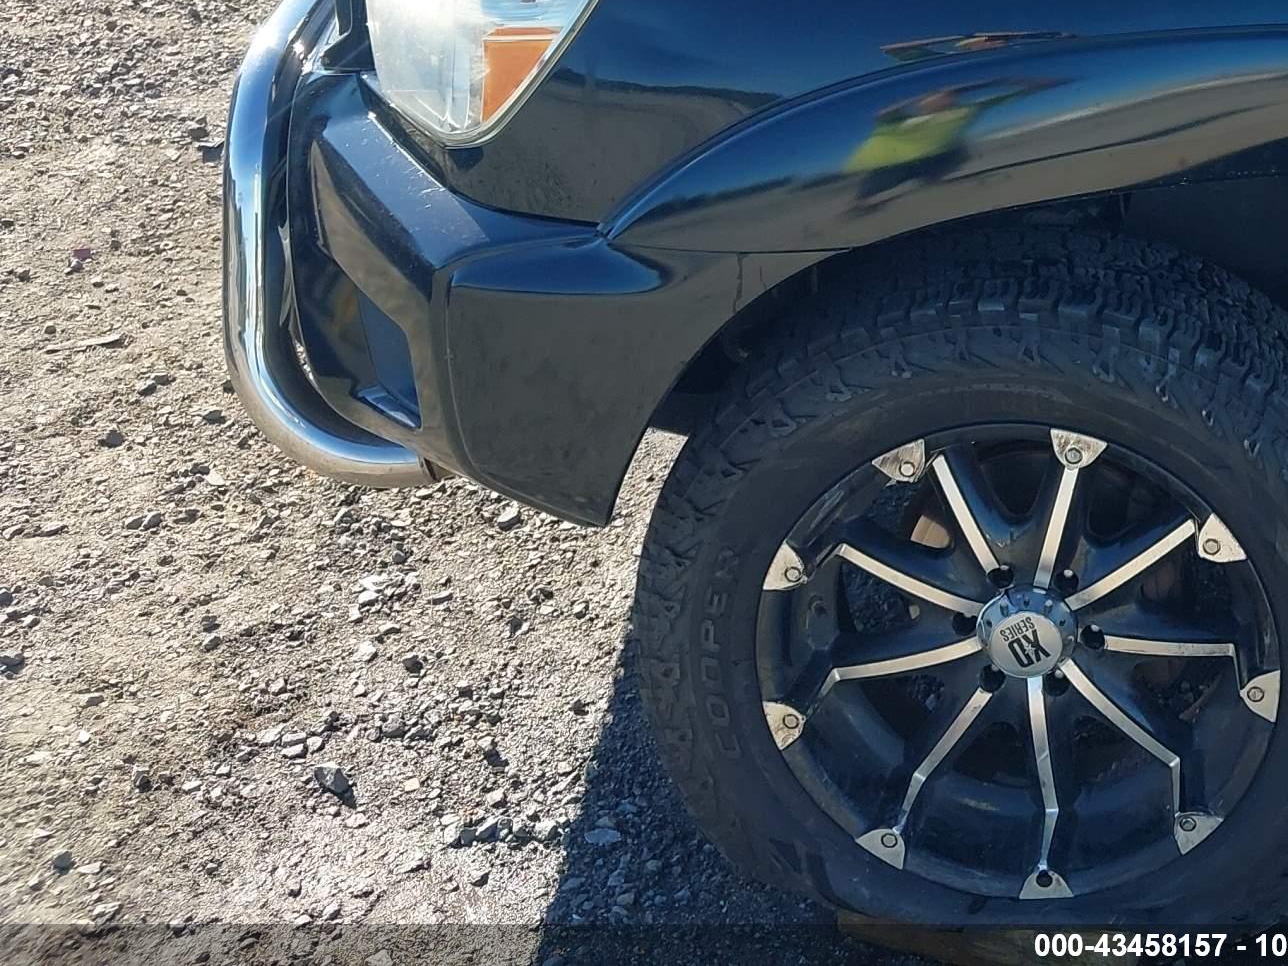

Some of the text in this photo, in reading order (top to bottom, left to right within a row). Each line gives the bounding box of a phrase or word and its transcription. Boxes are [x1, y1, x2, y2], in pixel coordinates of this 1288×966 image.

[1000, 616, 1036, 642] SERIES
[1008, 629, 1052, 668] XD
[701, 546, 742, 760] COOPER
